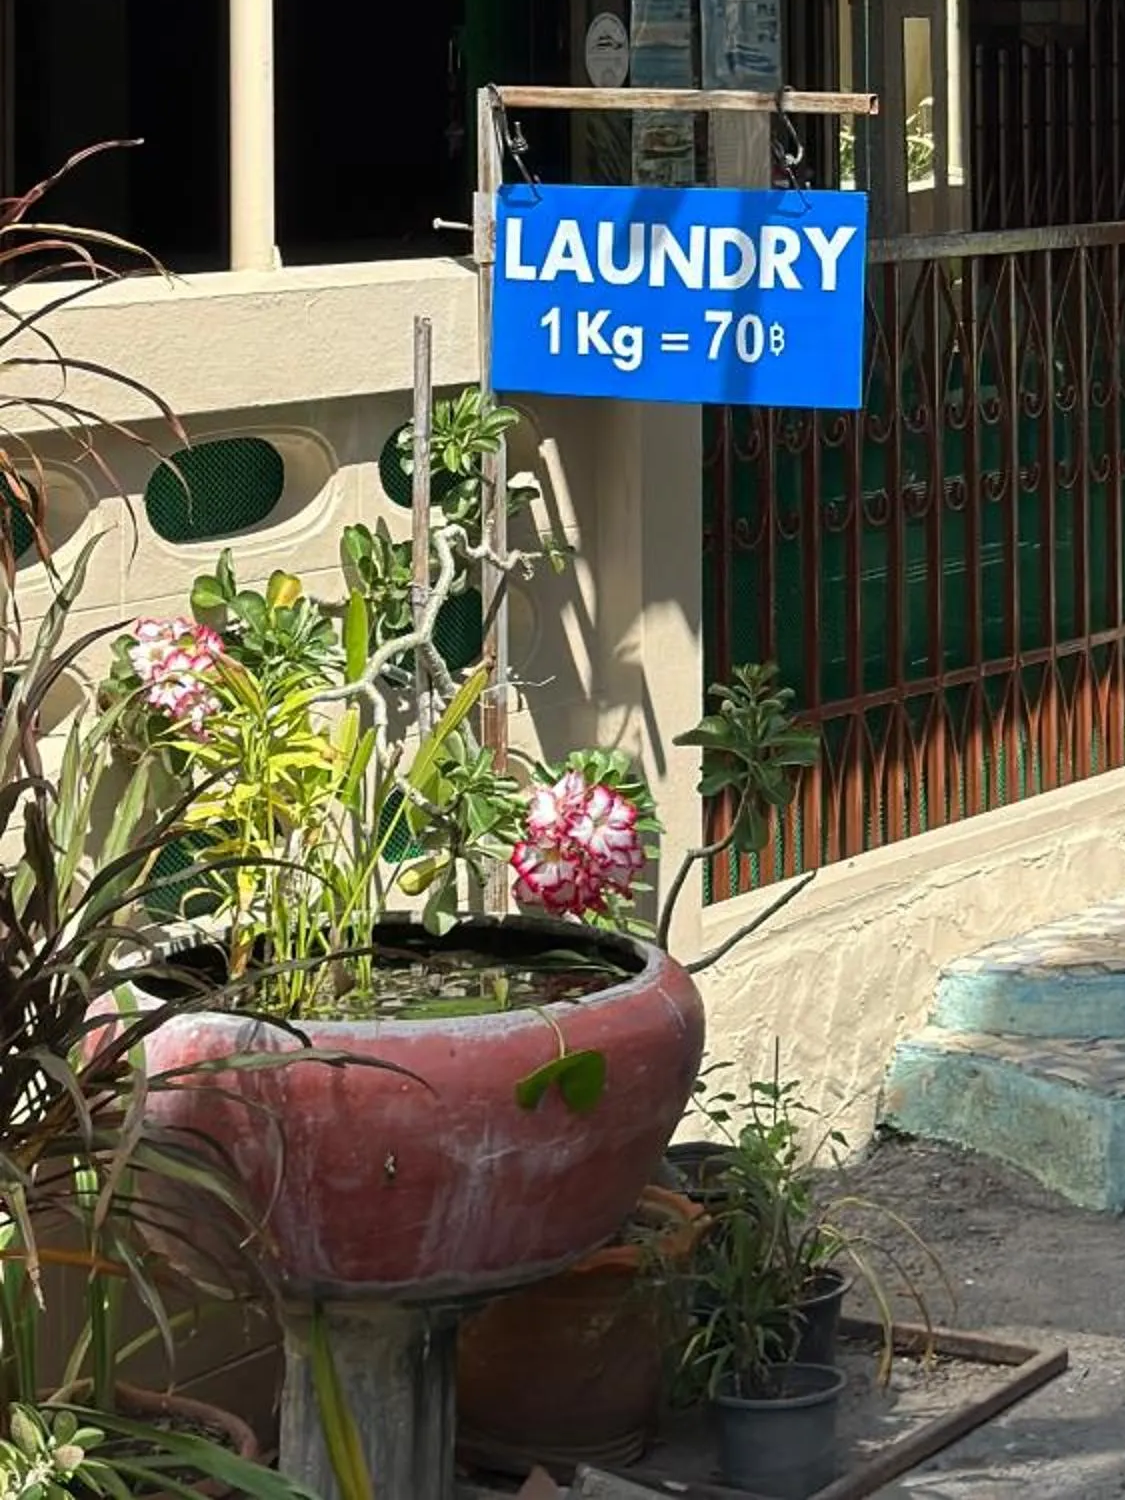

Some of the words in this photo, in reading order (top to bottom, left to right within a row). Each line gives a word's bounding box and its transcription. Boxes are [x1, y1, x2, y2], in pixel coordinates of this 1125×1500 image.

[504, 217, 857, 292] LAUNDRY
[540, 307, 561, 355] 1
[576, 309, 644, 372] Kg
